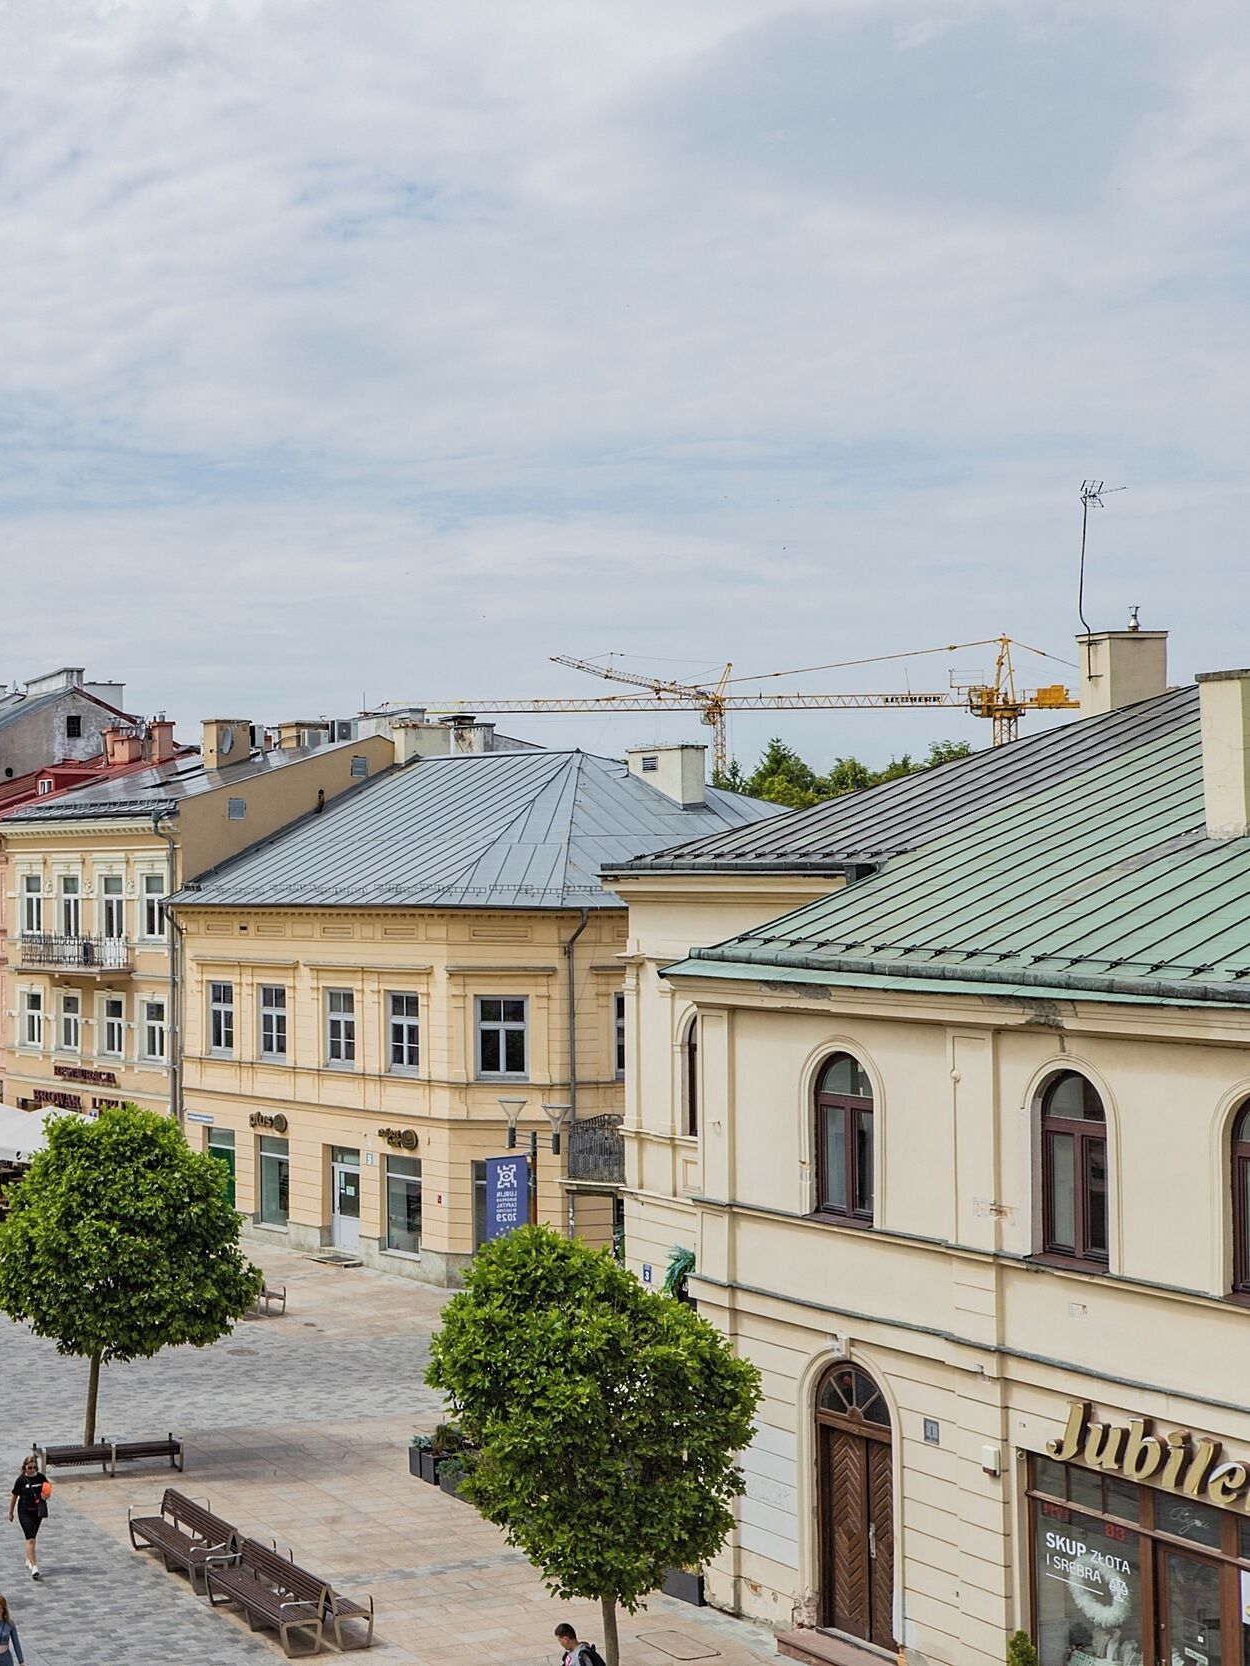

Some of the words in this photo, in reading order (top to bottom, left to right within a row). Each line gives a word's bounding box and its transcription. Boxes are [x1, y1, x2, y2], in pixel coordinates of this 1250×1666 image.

[249, 1111, 273, 1128] plus
[1046, 1400, 1250, 1512] Jubile
[1046, 1532, 1087, 1557] SKUP
[1090, 1550, 1131, 1575] ZŁOTA
[1053, 1555, 1102, 1584] SREBRA
